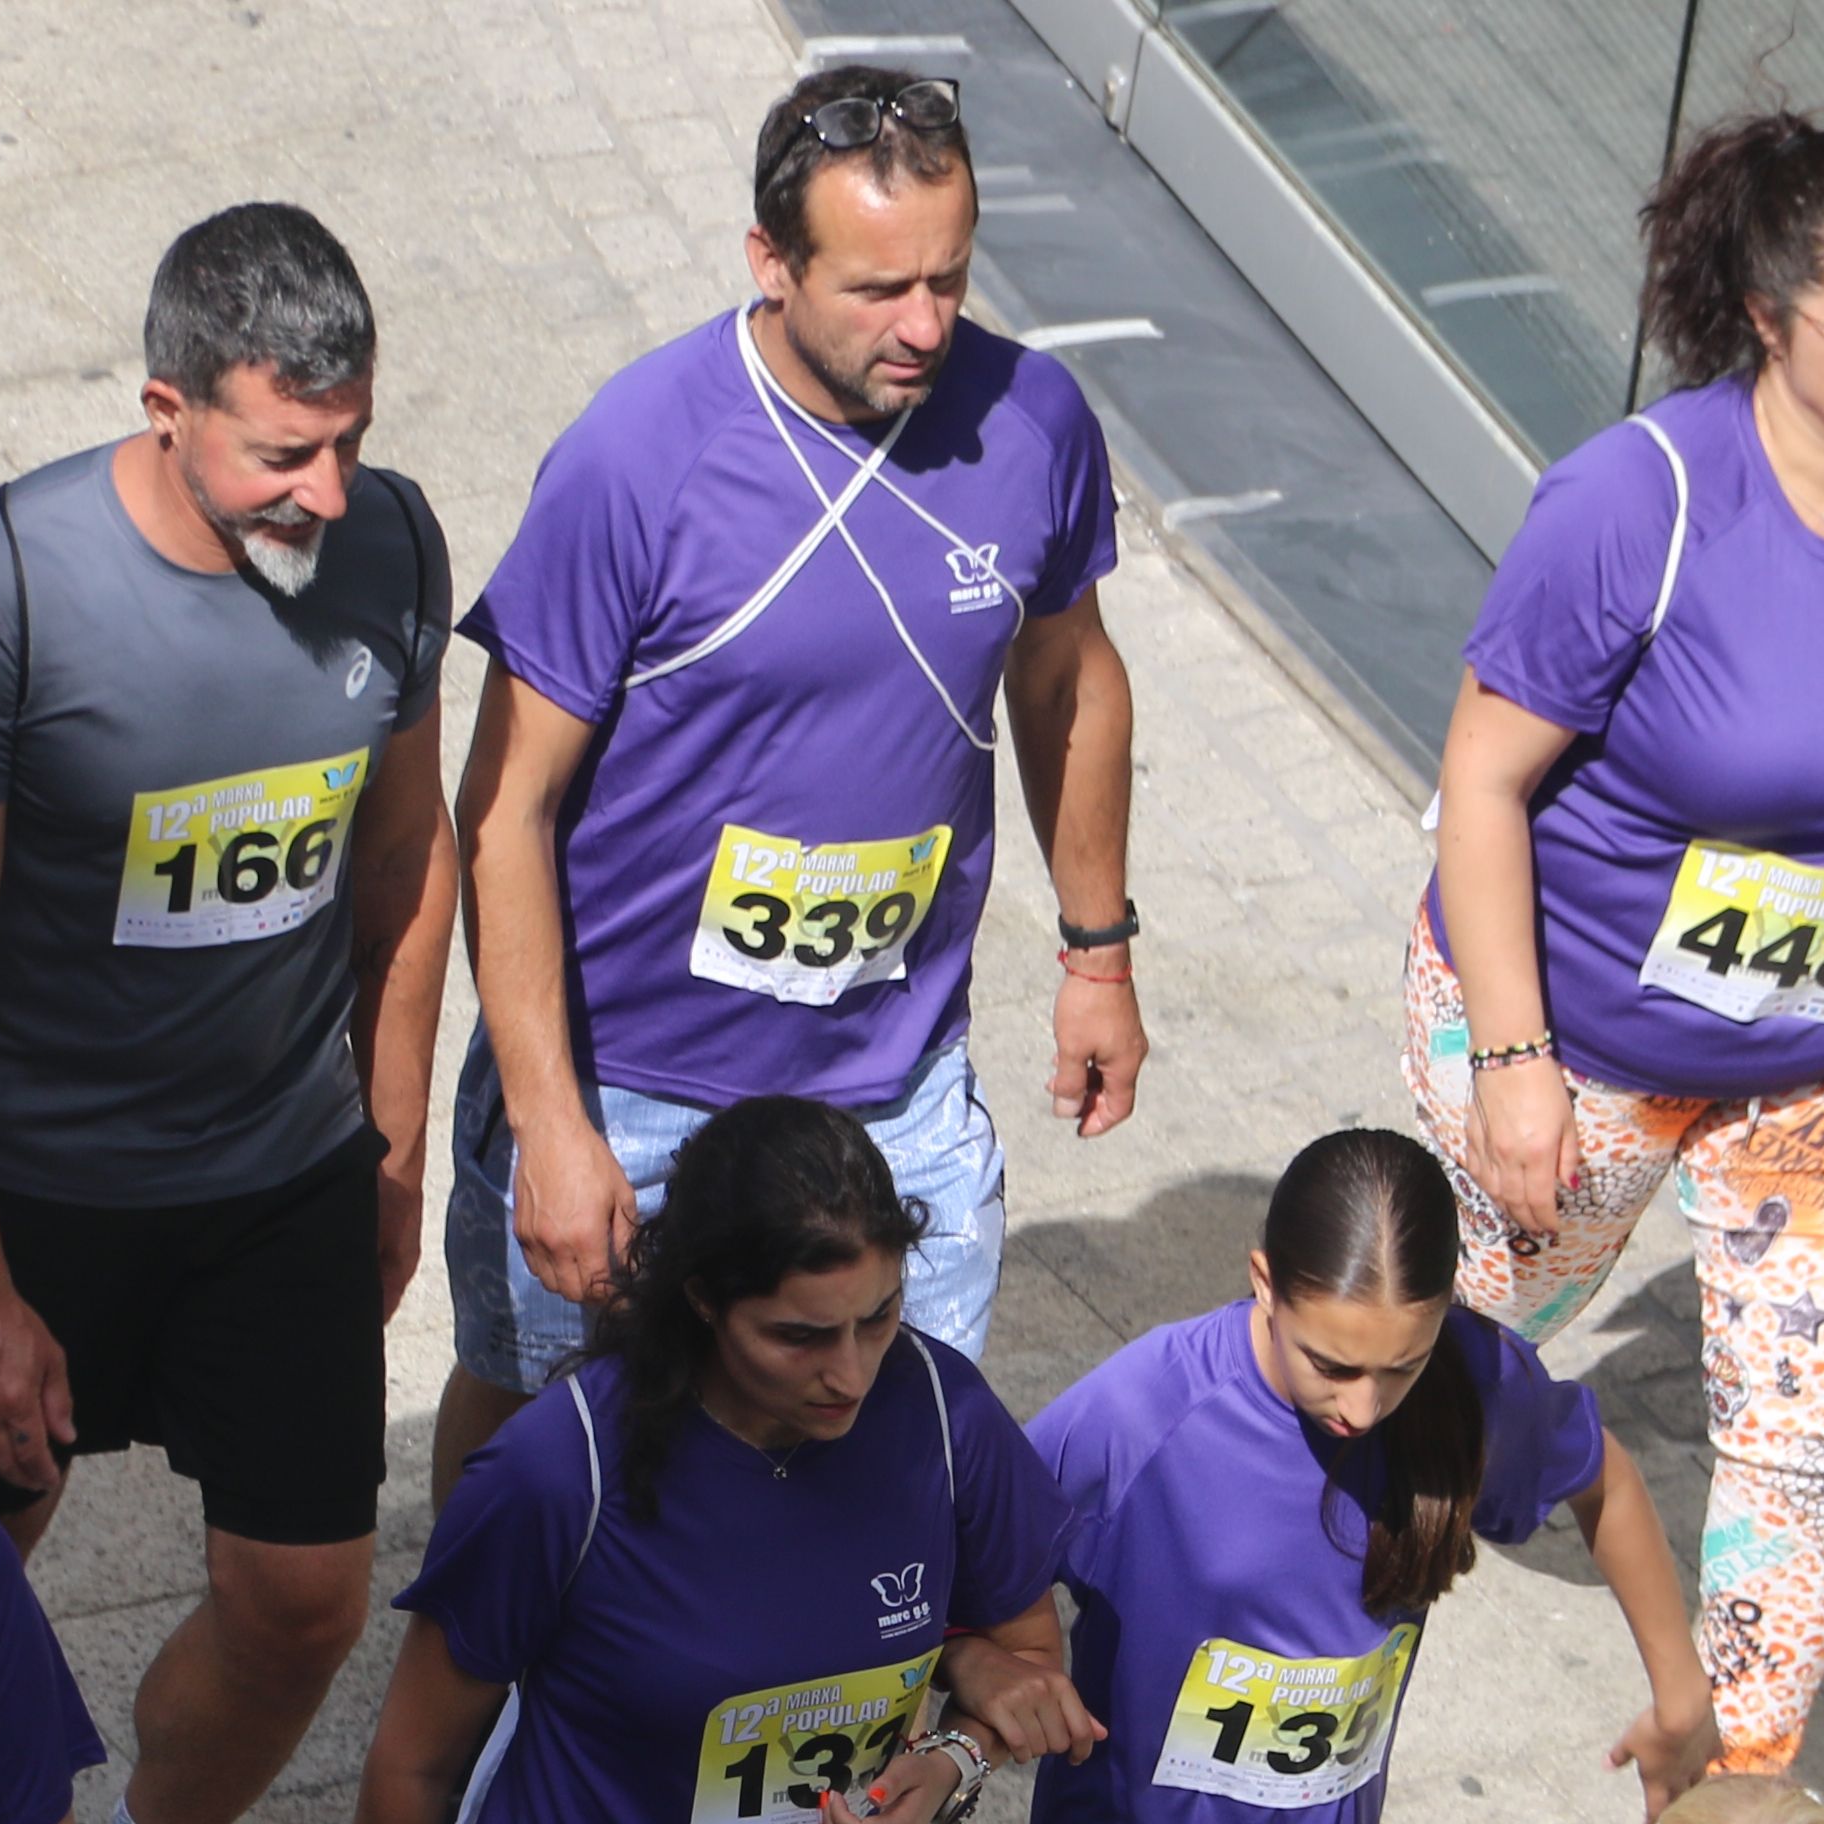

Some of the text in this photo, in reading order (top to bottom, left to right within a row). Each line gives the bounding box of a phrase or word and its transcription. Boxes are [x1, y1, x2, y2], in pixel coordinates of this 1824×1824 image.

[212, 782, 264, 808] MARXA
[210, 795, 312, 833] POPULAR
[154, 817, 338, 914] 166
[801, 853, 858, 871] MARXA
[795, 870, 897, 895] POPULAR
[1766, 864, 1824, 896] MARXA
[722, 891, 916, 968] 339
[1271, 1676, 1373, 1706] POPULAR
[1279, 1667, 1337, 1684] MARXA
[786, 1685, 842, 1711] MARXA
[782, 1697, 889, 1735] POPULAR
[1205, 1684, 1382, 1775] 135
